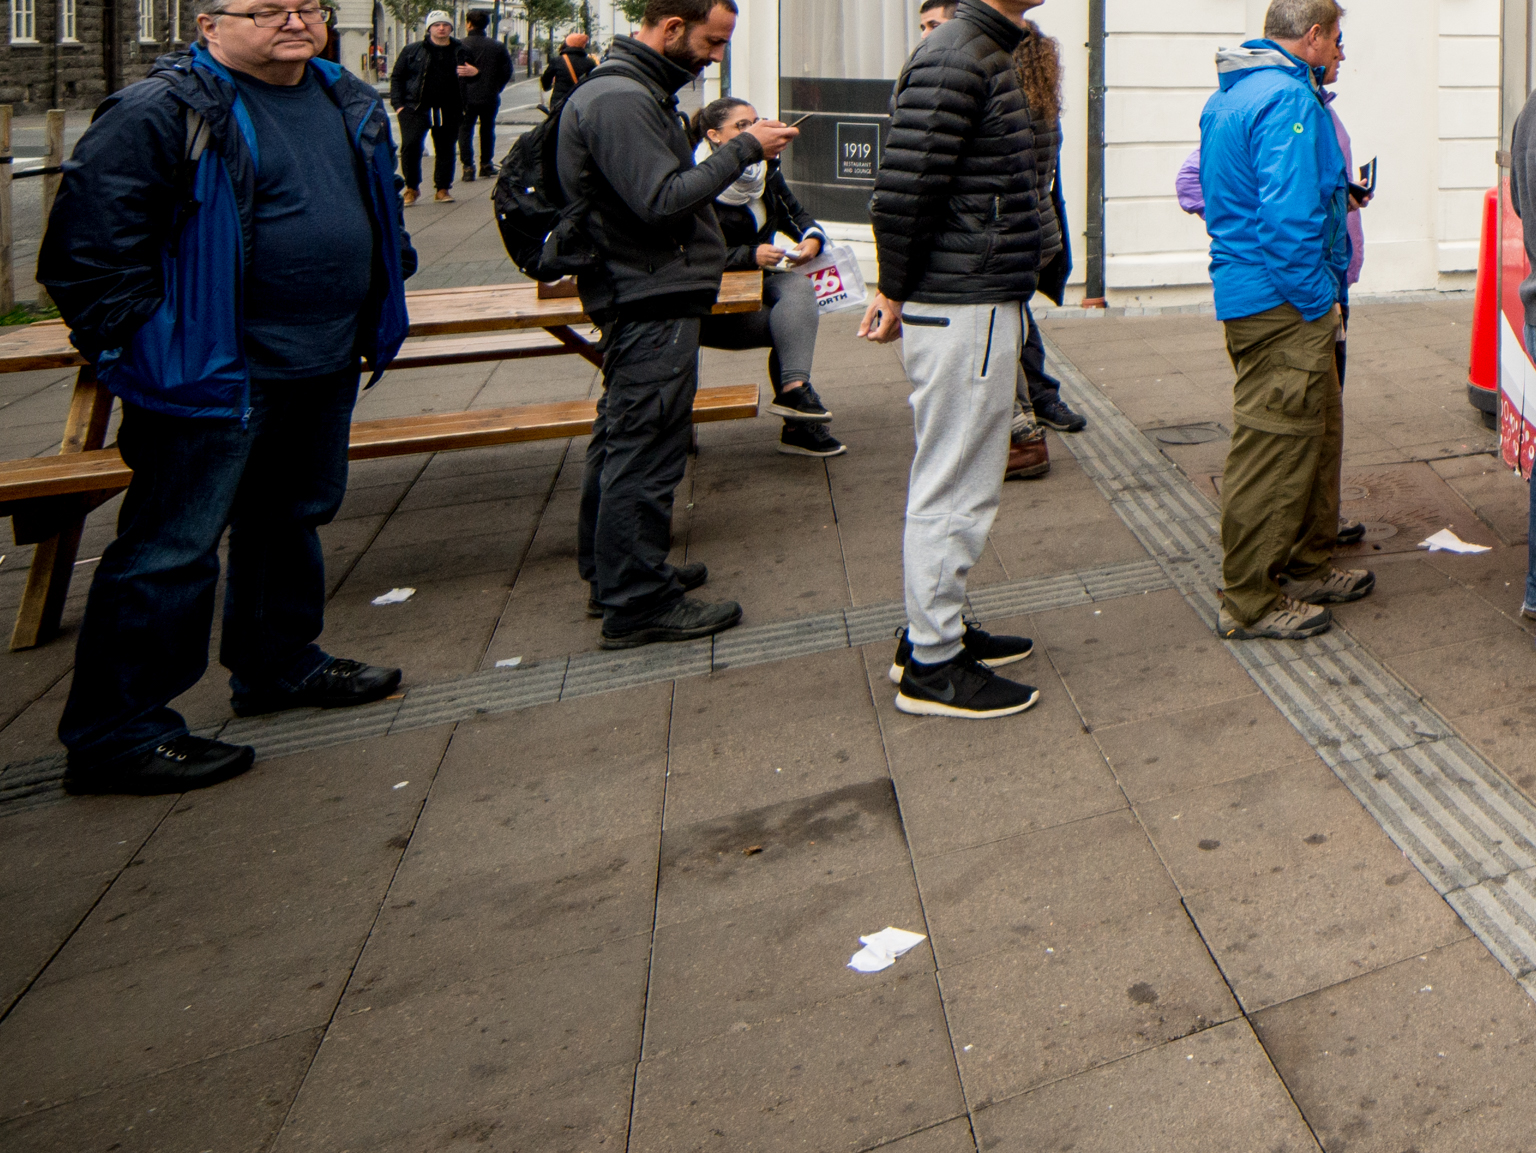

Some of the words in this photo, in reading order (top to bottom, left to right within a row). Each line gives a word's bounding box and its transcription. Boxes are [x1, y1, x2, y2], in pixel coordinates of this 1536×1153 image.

[844, 142, 871, 159] 1919
[843, 160, 872, 168] RESTAURANT
[817, 292, 848, 307] ORTH
